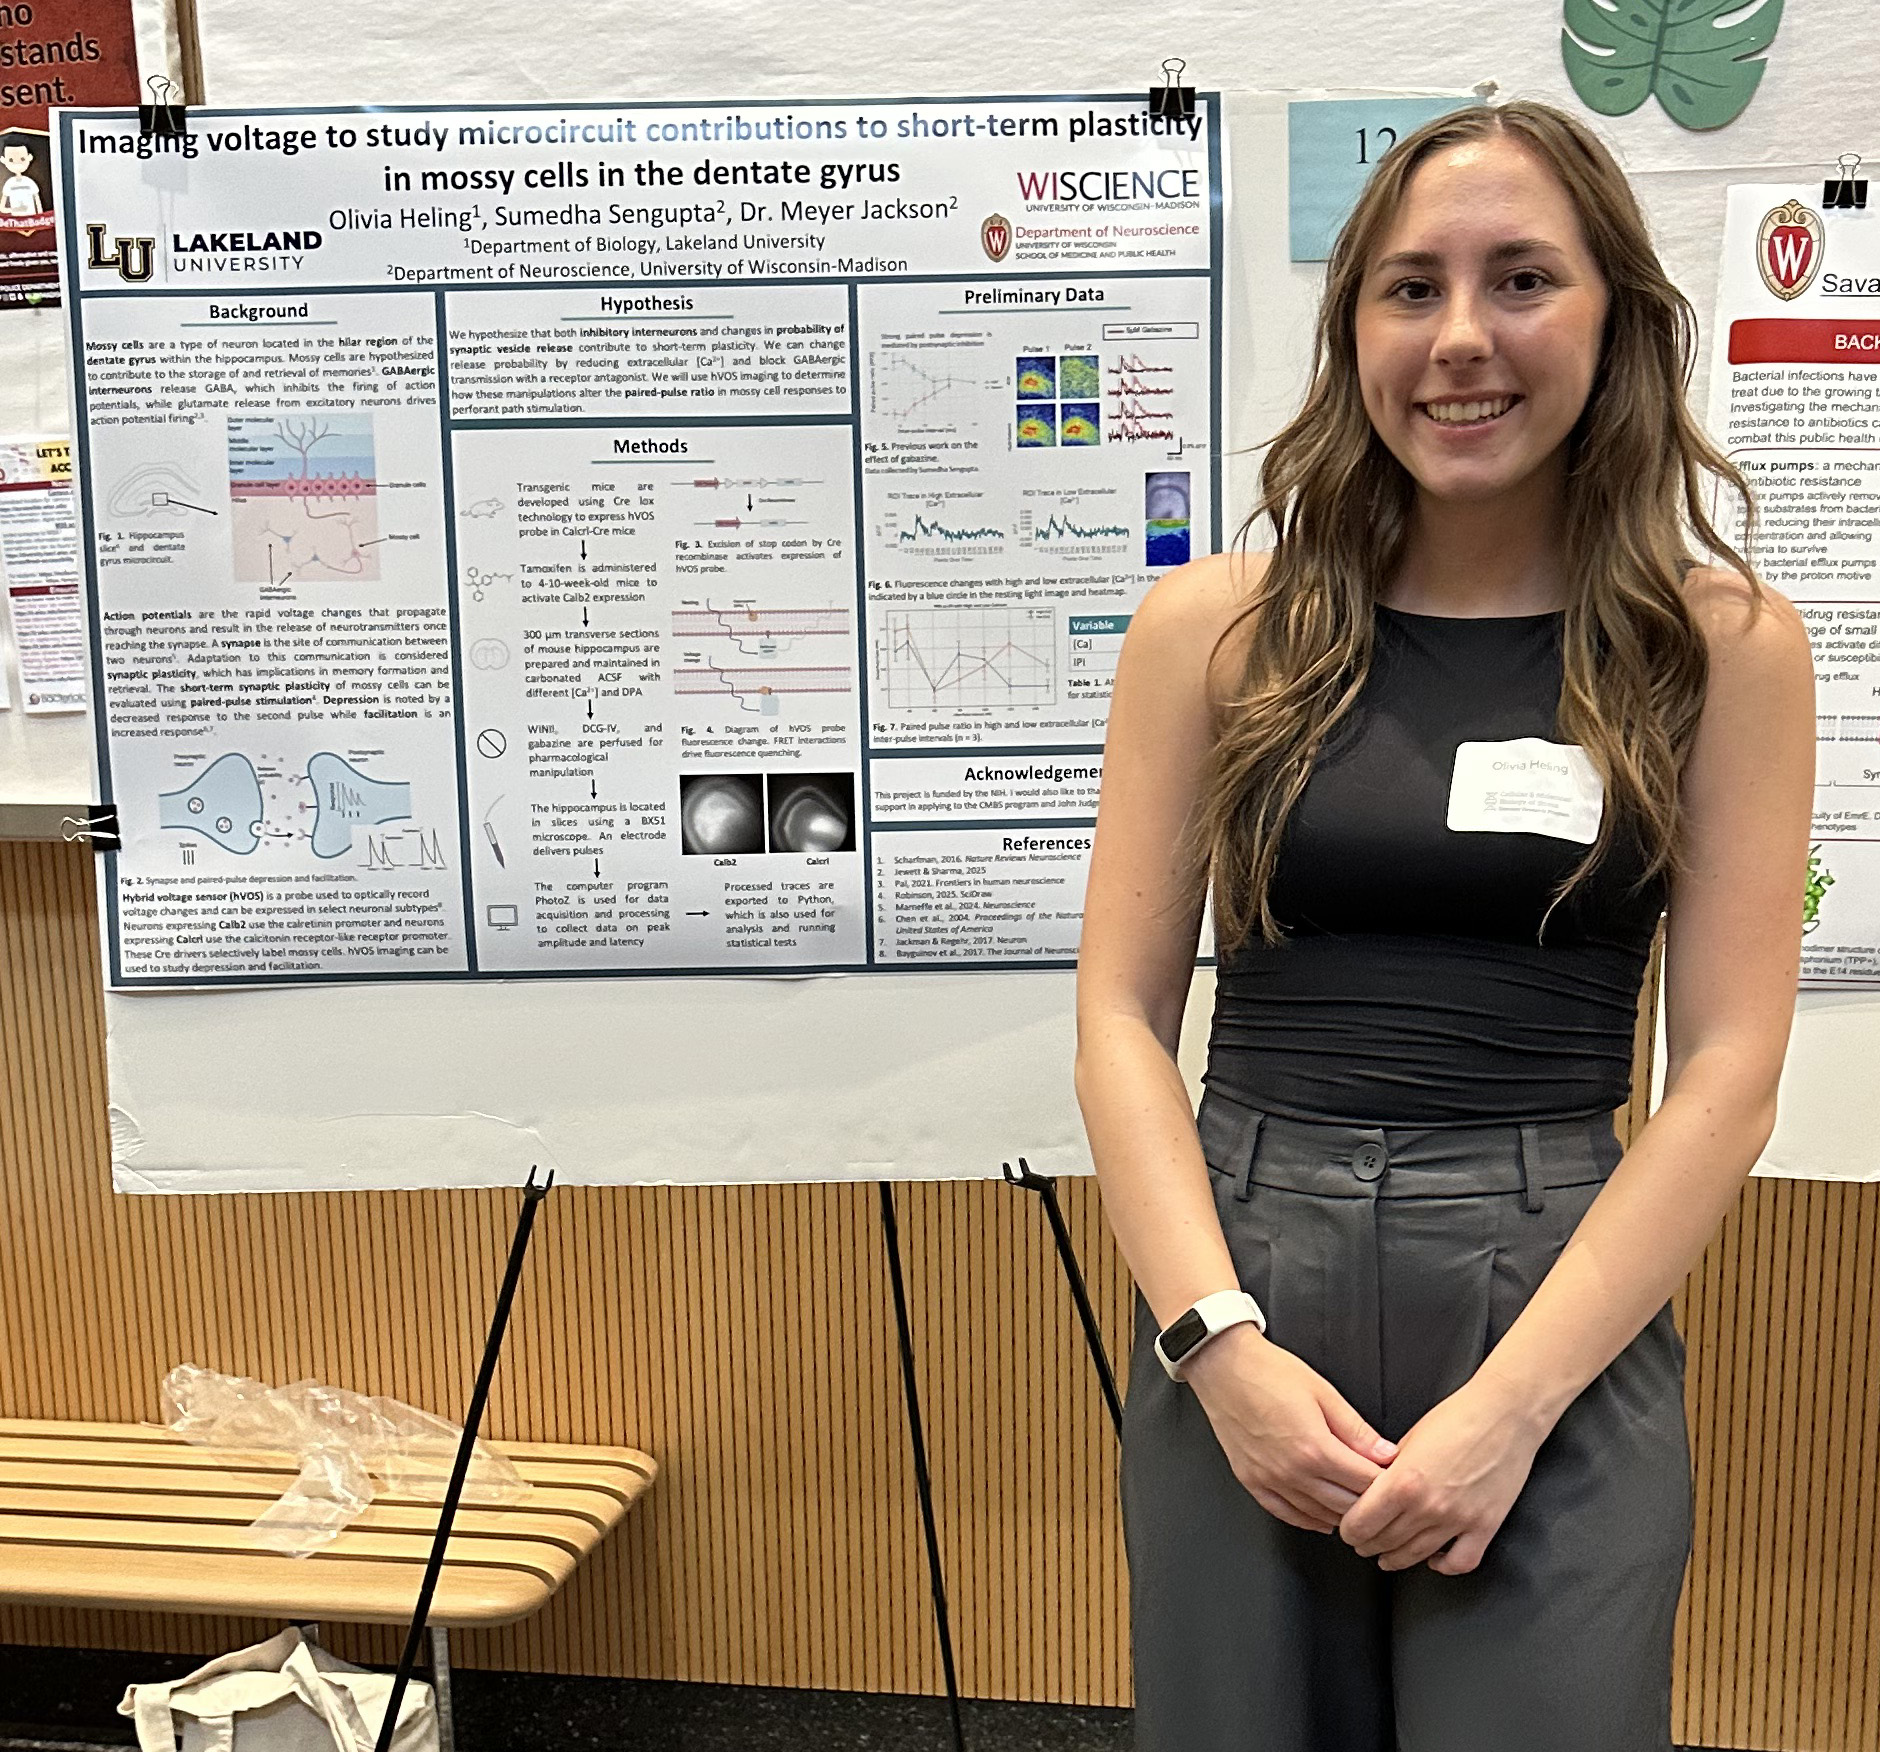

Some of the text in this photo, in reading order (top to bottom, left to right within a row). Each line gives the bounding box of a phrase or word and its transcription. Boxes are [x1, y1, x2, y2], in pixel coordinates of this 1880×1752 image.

[0, 32, 100, 66] stands
[0, 77, 74, 106] sent.
[79, 108, 1202, 159] Imaging voltage to study microcircuit contributions to short-term plasticity
[384, 159, 900, 195] in mossy cells in the dentate gyrus
[1017, 169, 1200, 200] WISCIENCE
[329, 208, 391, 230] Olivia
[495, 204, 600, 226] Sumedha
[740, 201, 772, 221] Dr.
[781, 201, 854, 225] Meyer
[1026, 204, 1080, 213] UNIVERSITY
[1082, 203, 1094, 212] OF
[1016, 224, 1200, 240] Department of Neuroscience
[172, 231, 322, 252] LAKELAND
[574, 236, 592, 252] of
[596, 236, 660, 254] Biology,
[665, 234, 737, 250] Lakeland
[743, 234, 825, 251] University
[173, 256, 304, 272] UNIVERSITY
[1773, 234, 1808, 281] W
[497, 262, 515, 279] of
[519, 263, 634, 278] Neuroscience,
[640, 261, 722, 277] University
[727, 259, 744, 275] of
[747, 257, 907, 274] Wisconsin-Madison
[964, 287, 1104, 305] Preliminary Data
[601, 295, 695, 314] Hypothesis
[209, 303, 309, 322] Background
[449, 330, 466, 340] We
[468, 329, 528, 341] hypothesize
[530, 328, 551, 338] that
[553, 328, 576, 338] both
[579, 327, 629, 338] inhibitory
[631, 327, 697, 336] interneurons
[699, 326, 718, 336] and
[720, 326, 761, 337] changes
[776, 324, 831, 336] probability
[833, 323, 844, 333] of
[85, 341, 117, 352] Mossy
[121, 339, 144, 350] cells
[148, 341, 165, 349] are
[169, 341, 175, 349] a
[179, 341, 202, 351] type
[206, 339, 217, 349] of
[262, 338, 299, 348] located
[303, 338, 313, 347] in
[316, 337, 334, 347] the
[338, 336, 361, 347] hilar
[365, 336, 397, 348] region
[401, 335, 413, 345] of
[416, 335, 433, 345] the
[1732, 370, 1877, 382] Bacterial infections have
[1731, 386, 1872, 399] treat due to the growing
[1730, 402, 1805, 414] Investigating
[1808, 401, 1827, 412] the
[1728, 417, 1868, 428] resistance to antibiotics
[613, 438, 689, 454] Methods
[1727, 432, 1875, 445] combat this public health
[1770, 462, 1818, 472] pumps:
[516, 482, 654, 494] Transgenic mice are
[1800, 477, 1862, 487] resistance
[517, 495, 654, 508] developed using Cre lox
[1769, 491, 1847, 502] pumps actively
[520, 577, 657, 588] to 4-10-week-old mice to
[1766, 571, 1871, 583] by the proton motive
[1072, 620, 1115, 631] Variable
[1073, 640, 1093, 650] [Ca]
[1492, 760, 1569, 775] Olivia Heling
[1002, 836, 1092, 851] References
[713, 858, 737, 866] Calb2
[726, 938, 797, 947] statistical tests
